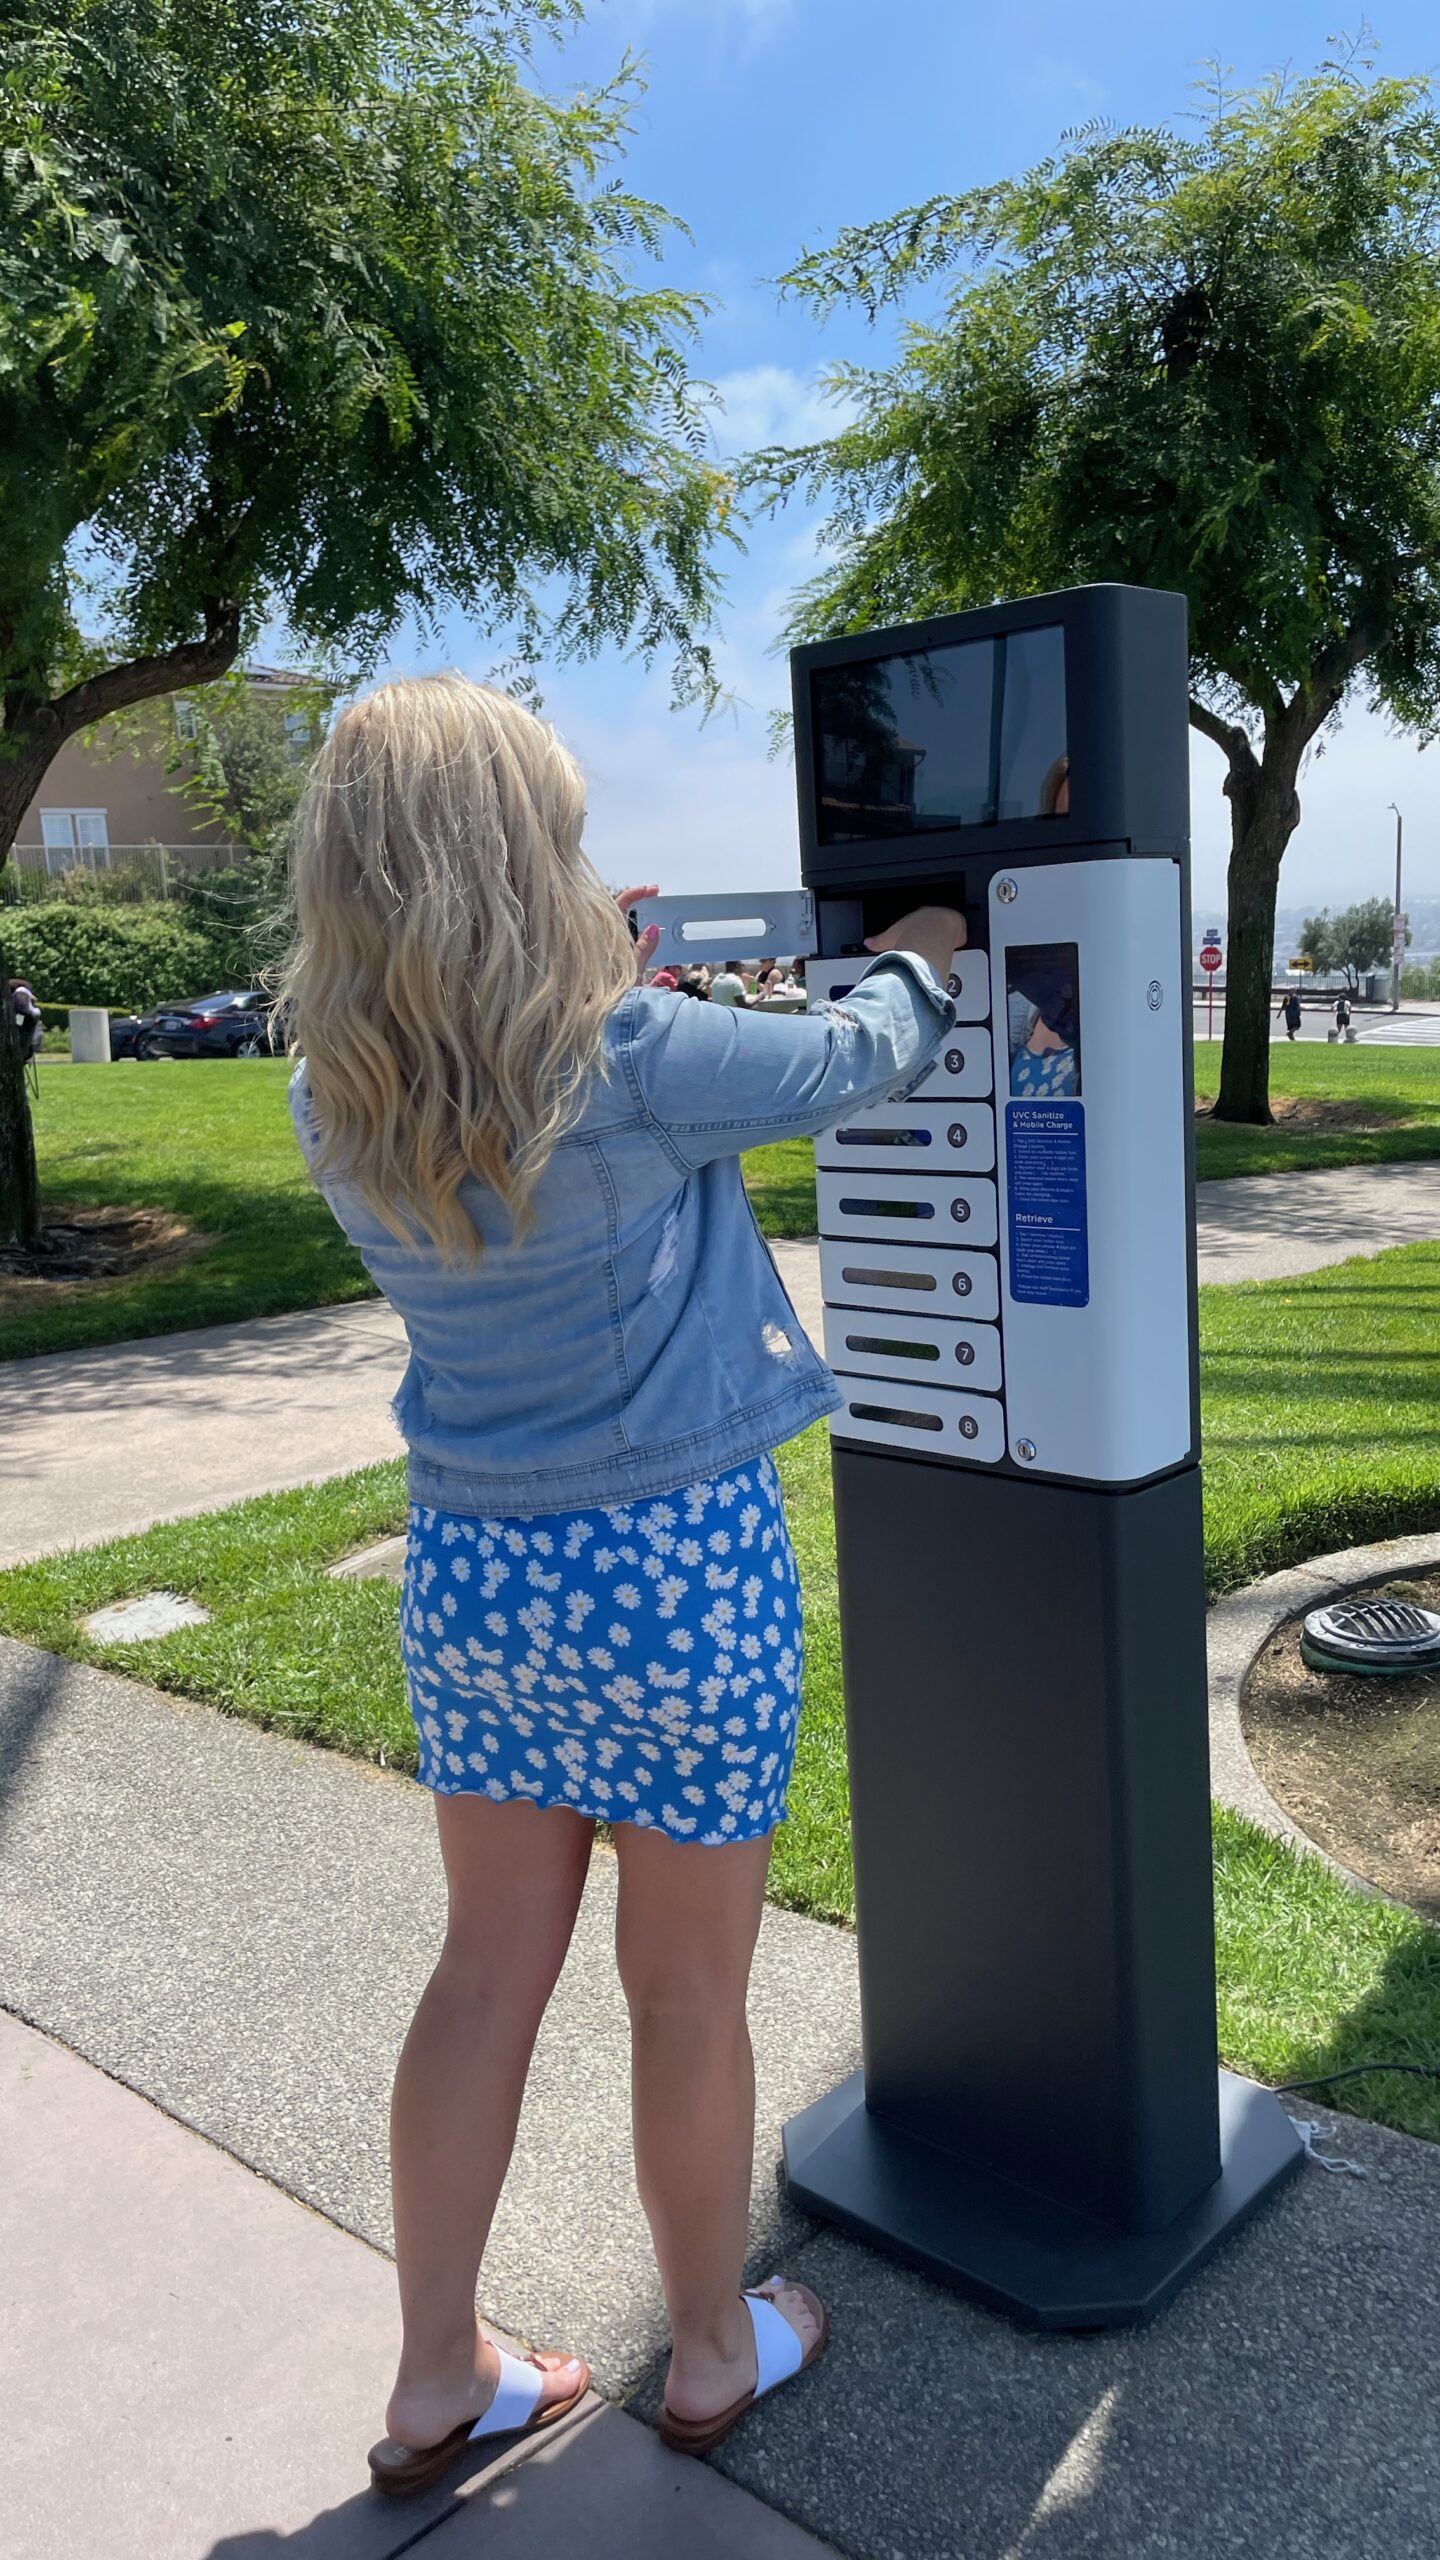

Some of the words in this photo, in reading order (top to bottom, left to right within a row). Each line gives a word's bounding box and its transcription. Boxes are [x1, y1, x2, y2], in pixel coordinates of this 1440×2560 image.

[1201, 954, 1221, 964] STOP
[947, 979, 957, 993] 2
[950, 1054, 959, 1068] 3
[1012, 1111, 1030, 1119] UVC
[1031, 1111, 1065, 1119] Sanitize
[1046, 1121, 1073, 1130] Charge
[952, 1128, 961, 1142] 4
[956, 1203, 965, 1217] 5
[1015, 1213, 1054, 1224] Retrieve
[957, 1278, 966, 1291] 6
[961, 1348, 969, 1361] 7
[964, 1421, 973, 1435] 8
